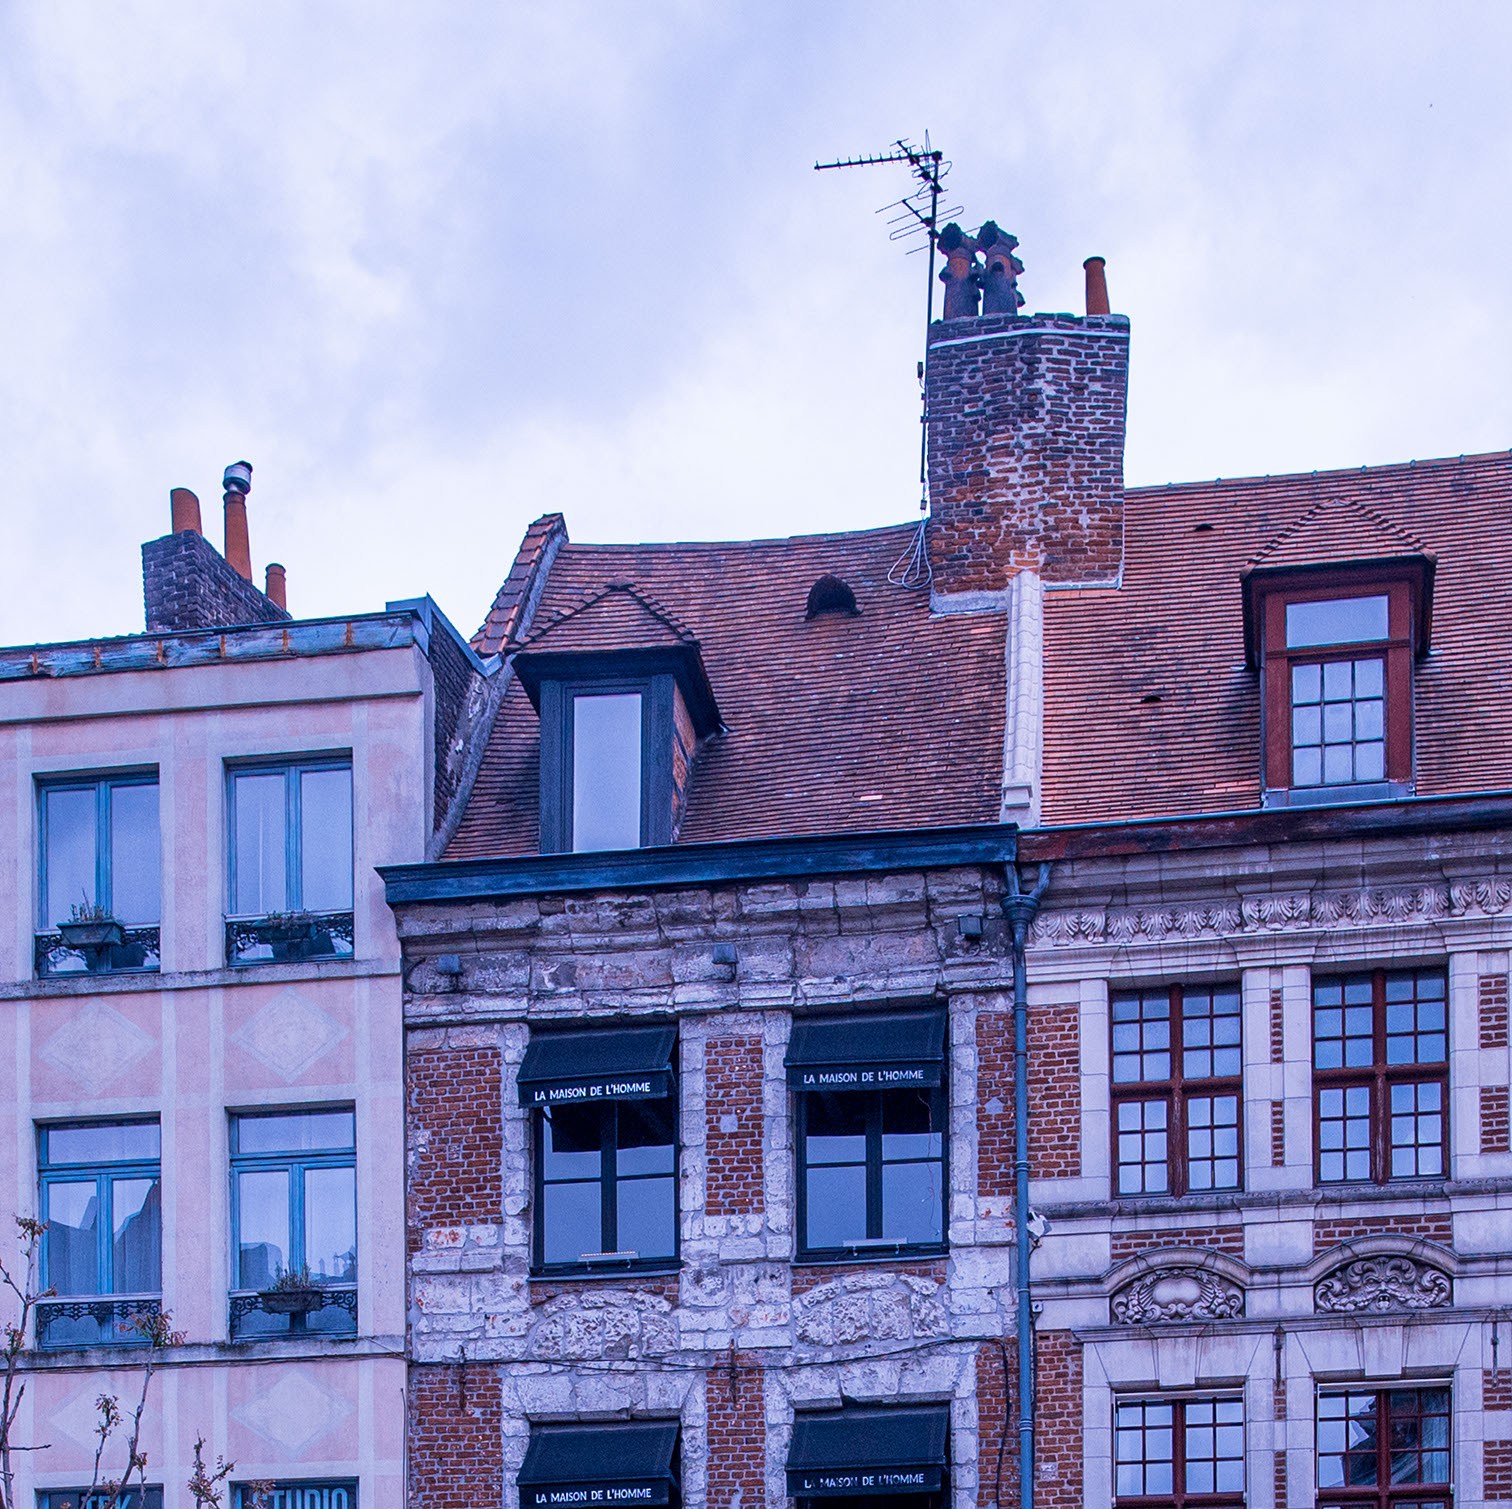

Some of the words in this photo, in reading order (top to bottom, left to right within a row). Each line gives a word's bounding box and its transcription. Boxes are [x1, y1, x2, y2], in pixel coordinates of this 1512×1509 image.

[804, 1074, 815, 1083] LA
[819, 1072, 857, 1083] MAISON
[861, 1072, 874, 1081] DE
[878, 1069, 924, 1081] L'HOMME
[535, 1091, 546, 1101] LA
[549, 1087, 586, 1100] MAISON
[590, 1086, 602, 1096] DE
[606, 1082, 651, 1095] L'HOMME
[862, 1476, 874, 1486] DE
[536, 1493, 547, 1503] LA
[550, 1491, 587, 1502] MAISON
[591, 1490, 603, 1500] DE
[606, 1488, 652, 1499] L'HOMME
